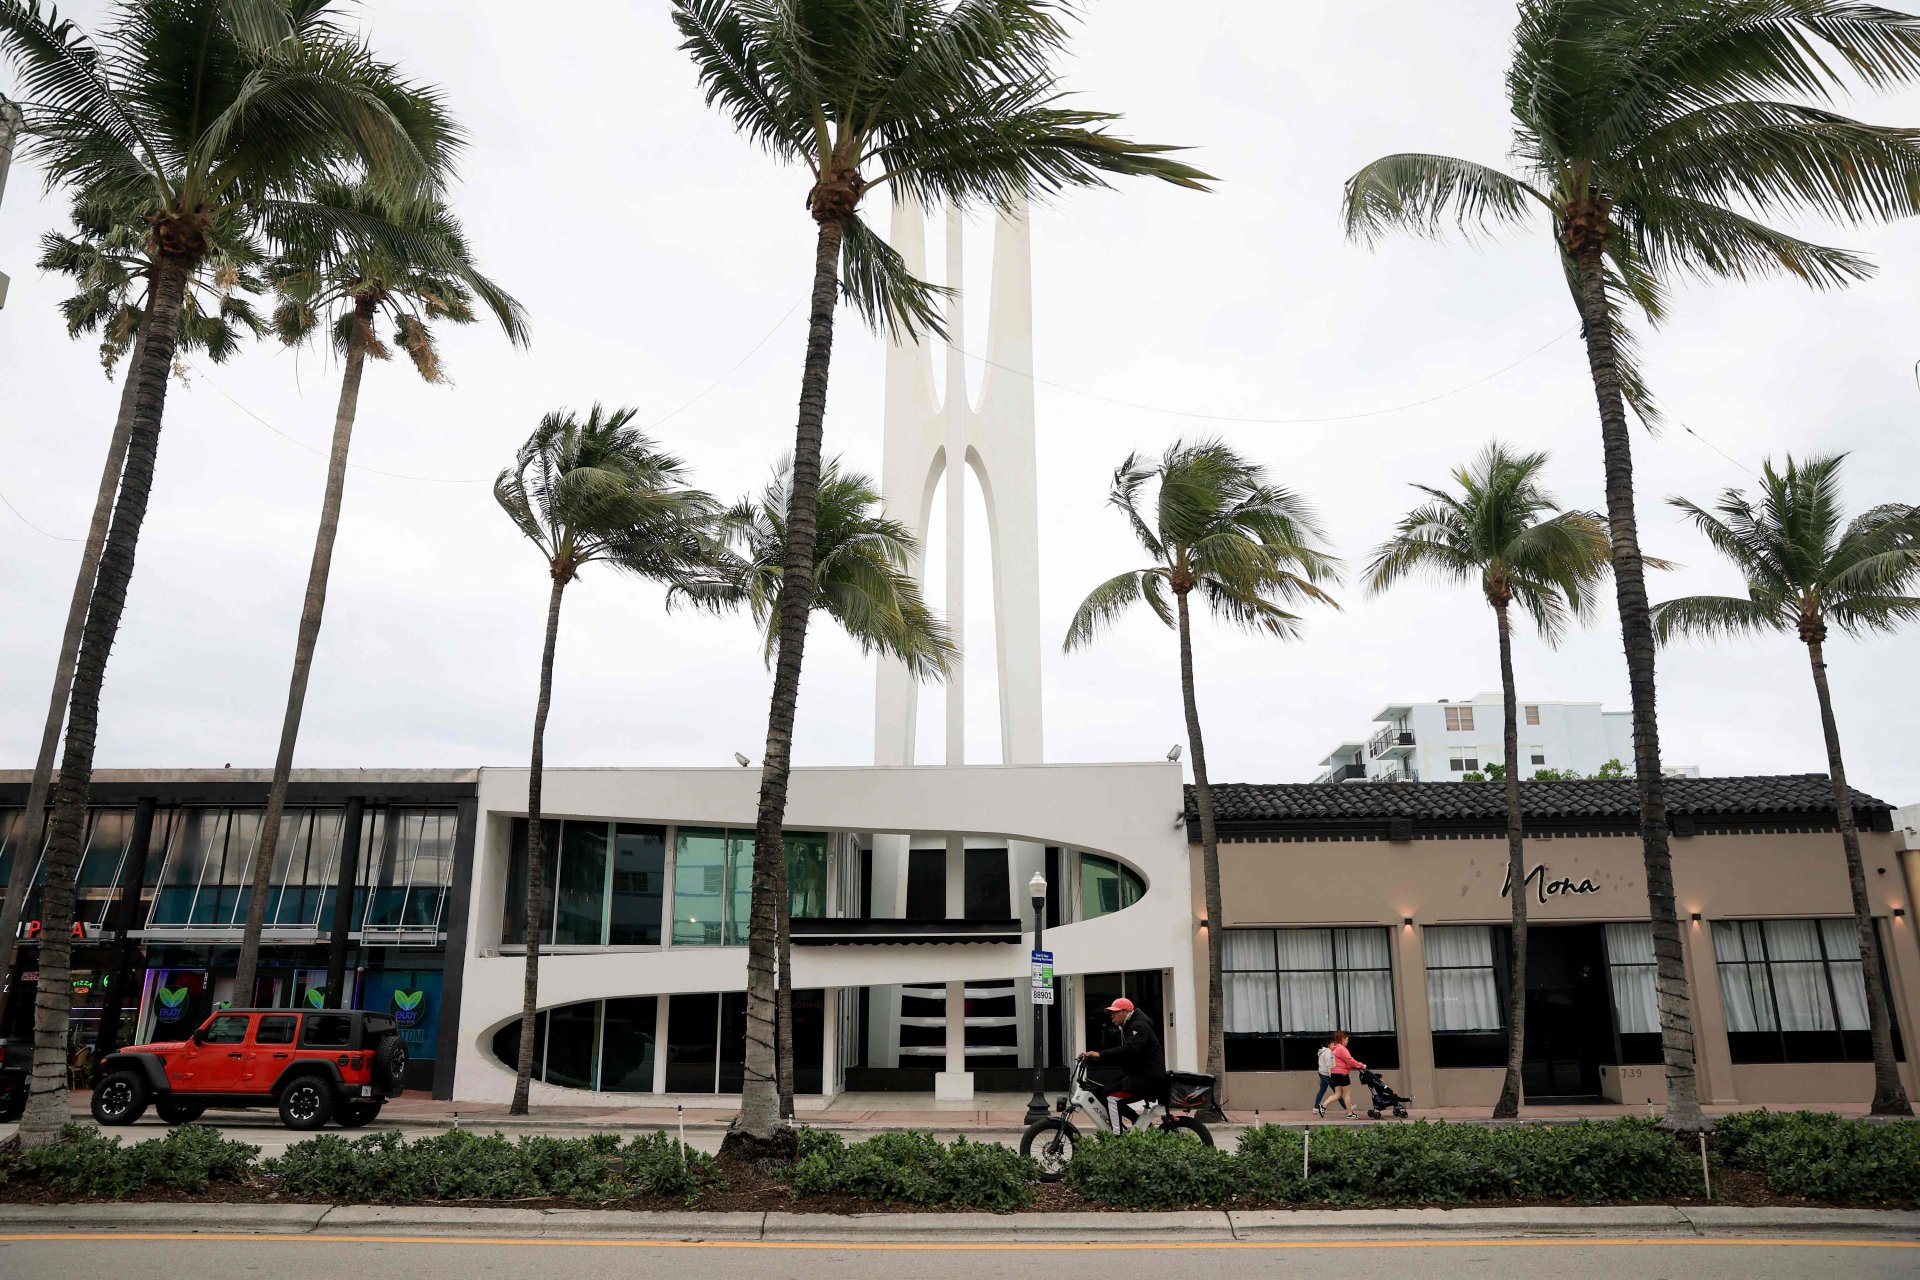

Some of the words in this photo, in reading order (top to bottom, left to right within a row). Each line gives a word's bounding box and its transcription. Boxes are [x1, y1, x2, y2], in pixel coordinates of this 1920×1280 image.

[1501, 862, 1601, 904] Mona
[72, 980, 93, 989] PIZZA
[1033, 991, 1052, 1000] 88901
[395, 1011, 417, 1020] ENJOY
[1621, 1068, 1642, 1079] 739
